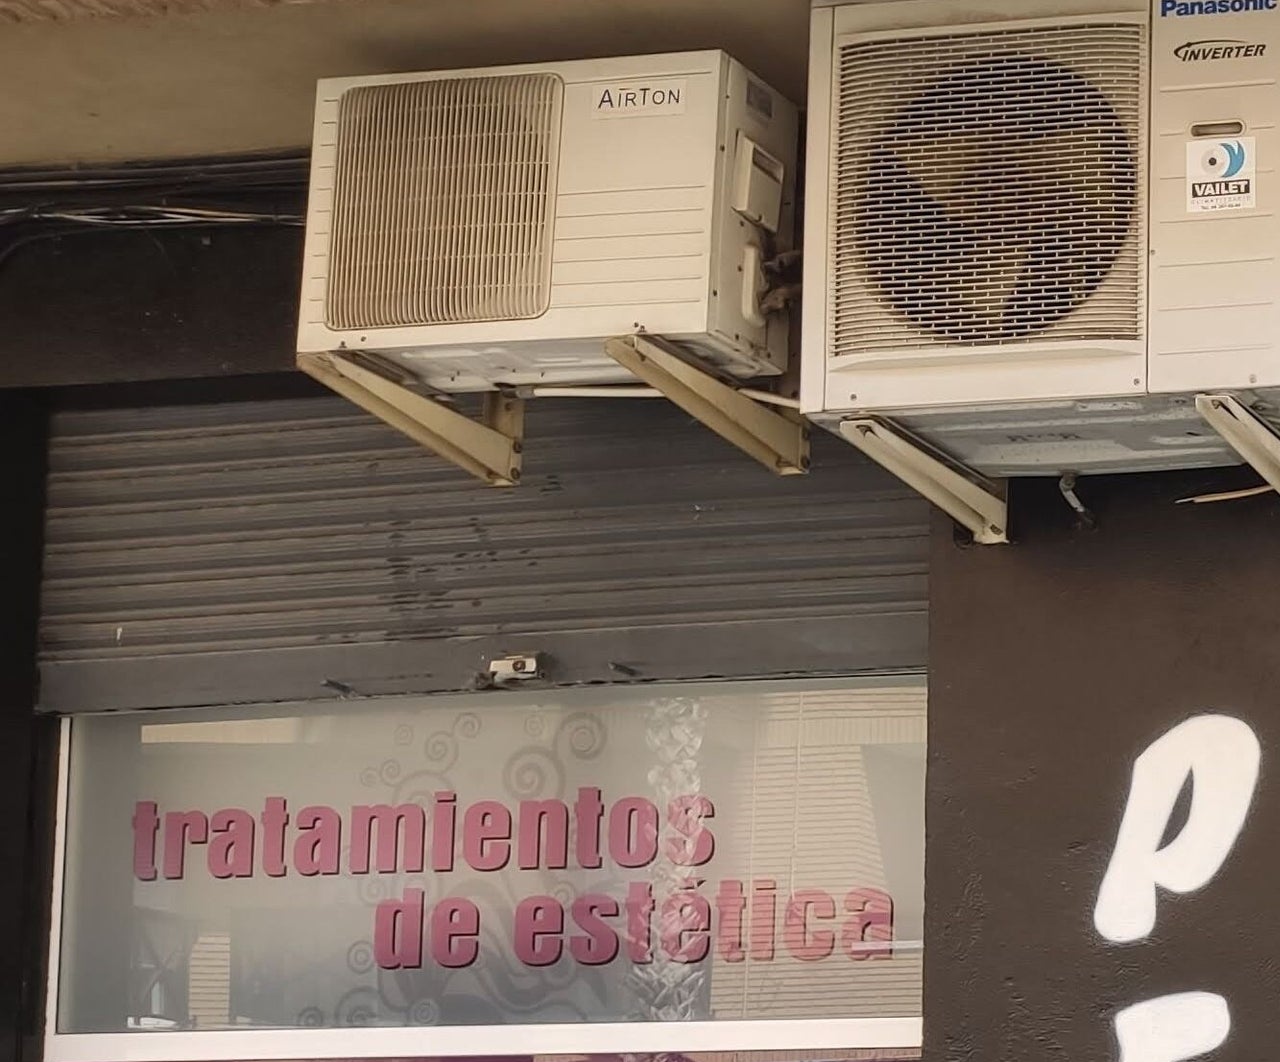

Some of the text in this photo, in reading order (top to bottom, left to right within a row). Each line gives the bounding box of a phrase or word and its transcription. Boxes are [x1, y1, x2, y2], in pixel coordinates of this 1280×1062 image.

[1161, 0, 1278, 16] Panasonic
[1182, 44, 1266, 61] INVERTER
[1194, 180, 1248, 196] VAILET
[132, 785, 716, 881] tratamientos
[374, 876, 895, 969] de estética
